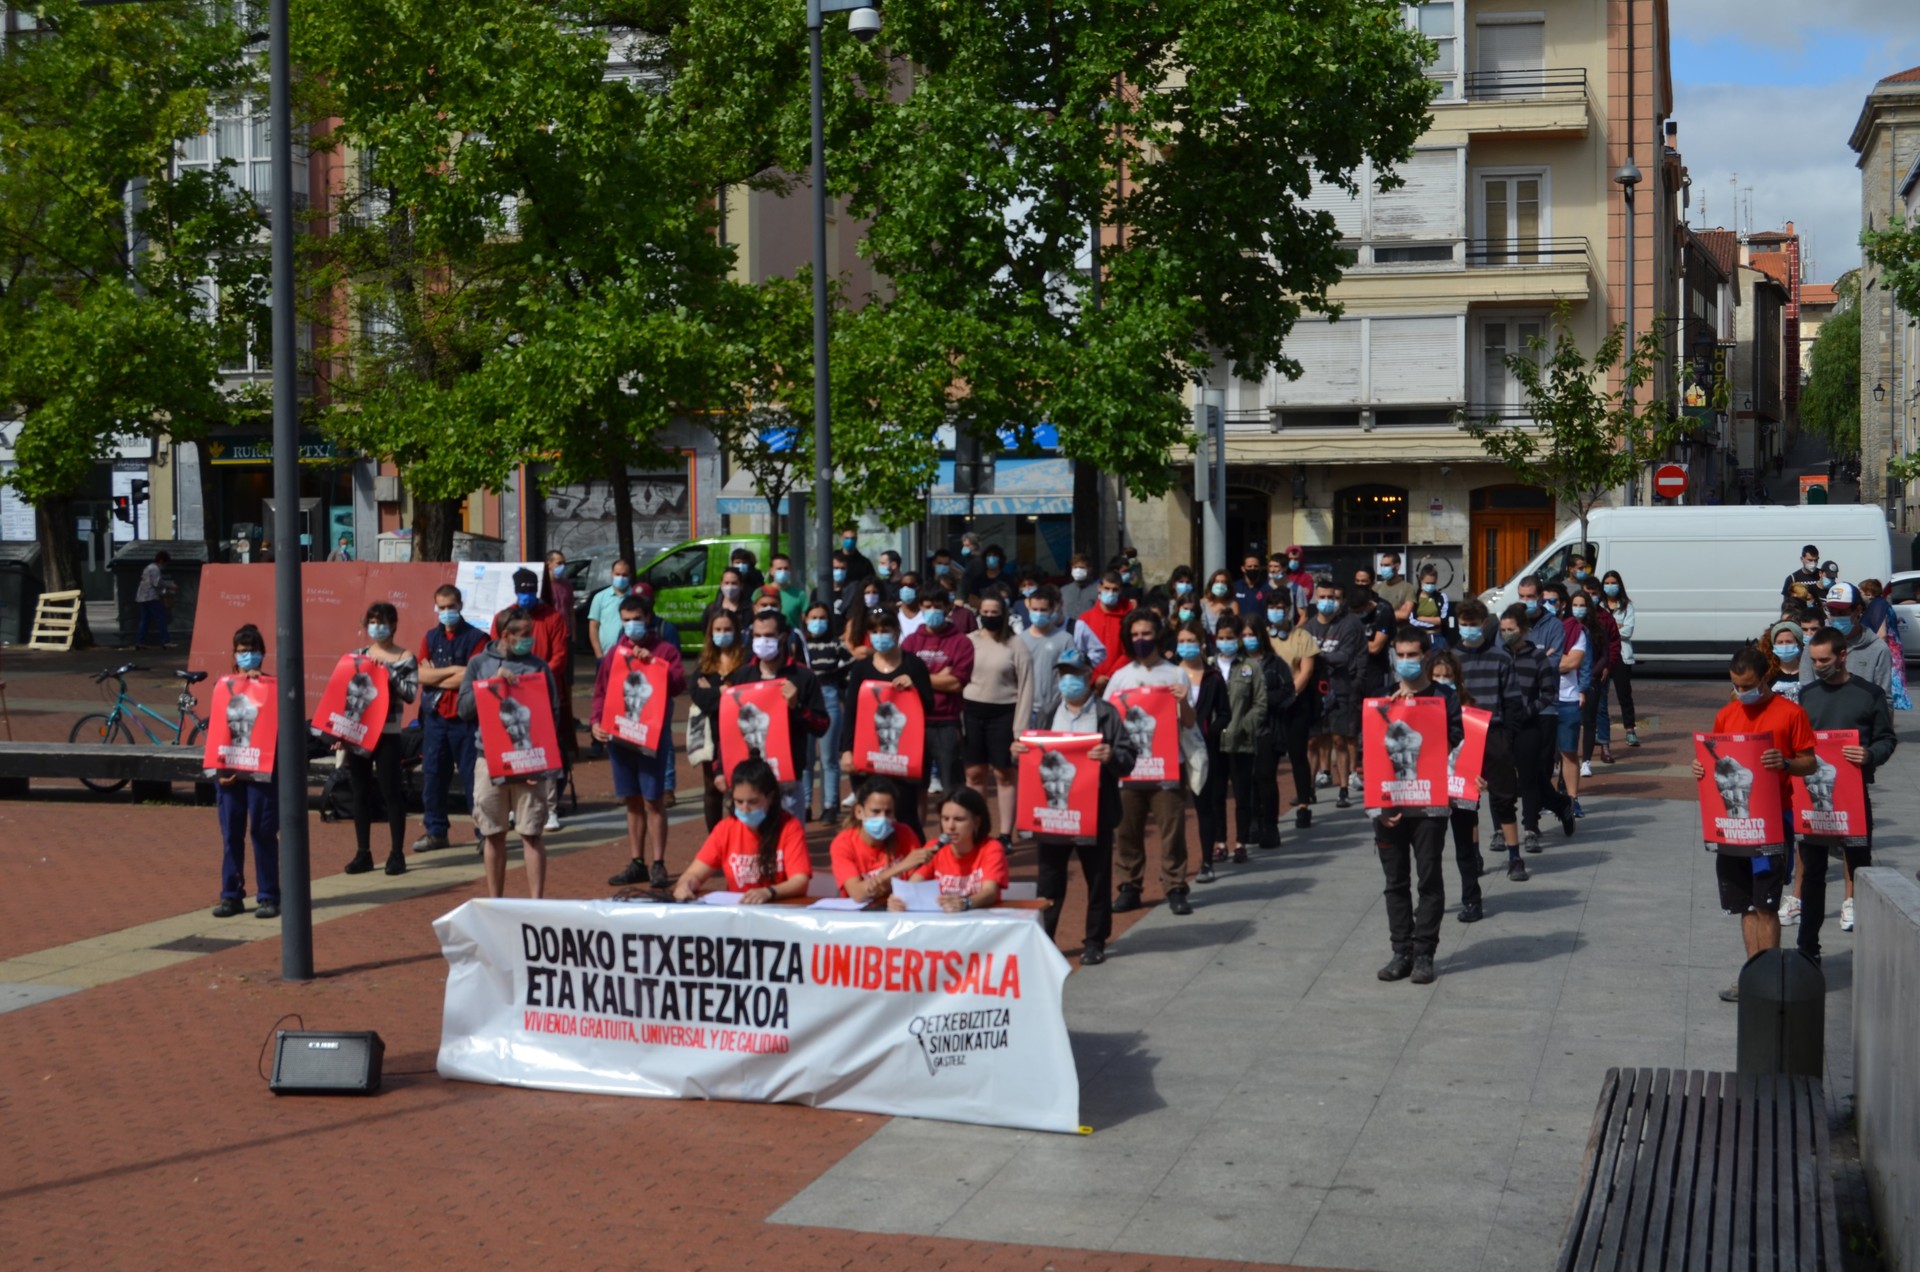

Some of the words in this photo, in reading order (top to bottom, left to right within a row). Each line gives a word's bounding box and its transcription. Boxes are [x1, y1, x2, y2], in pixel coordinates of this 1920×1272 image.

[1381, 779, 1431, 792] SINDICATO
[1390, 790, 1431, 801] VIVIENDA
[1801, 810, 1848, 821] SINDICATO
[1715, 817, 1765, 829] SINDICATO
[1809, 820, 1848, 831] VIVIENDA
[1723, 828, 1765, 840] VIVIENDA
[522, 923, 616, 971] DOAKO
[622, 933, 804, 984] ETXEBIZITZA
[811, 944, 1021, 999] UNIBERTSALA
[526, 966, 576, 1009] ETA
[582, 973, 789, 1029] KALITATEZKOA
[926, 1008, 1010, 1034] ETXEBIZITZA
[524, 1011, 577, 1036] VIVIENDA
[580, 1016, 640, 1044] GRATUITA,
[641, 1023, 707, 1049] UNIVERSAL
[710, 1029, 720, 1050] Y
[720, 1031, 738, 1053] DE
[738, 1032, 790, 1055] CALIDAD
[930, 1030, 1008, 1054] SINDIKATUA
